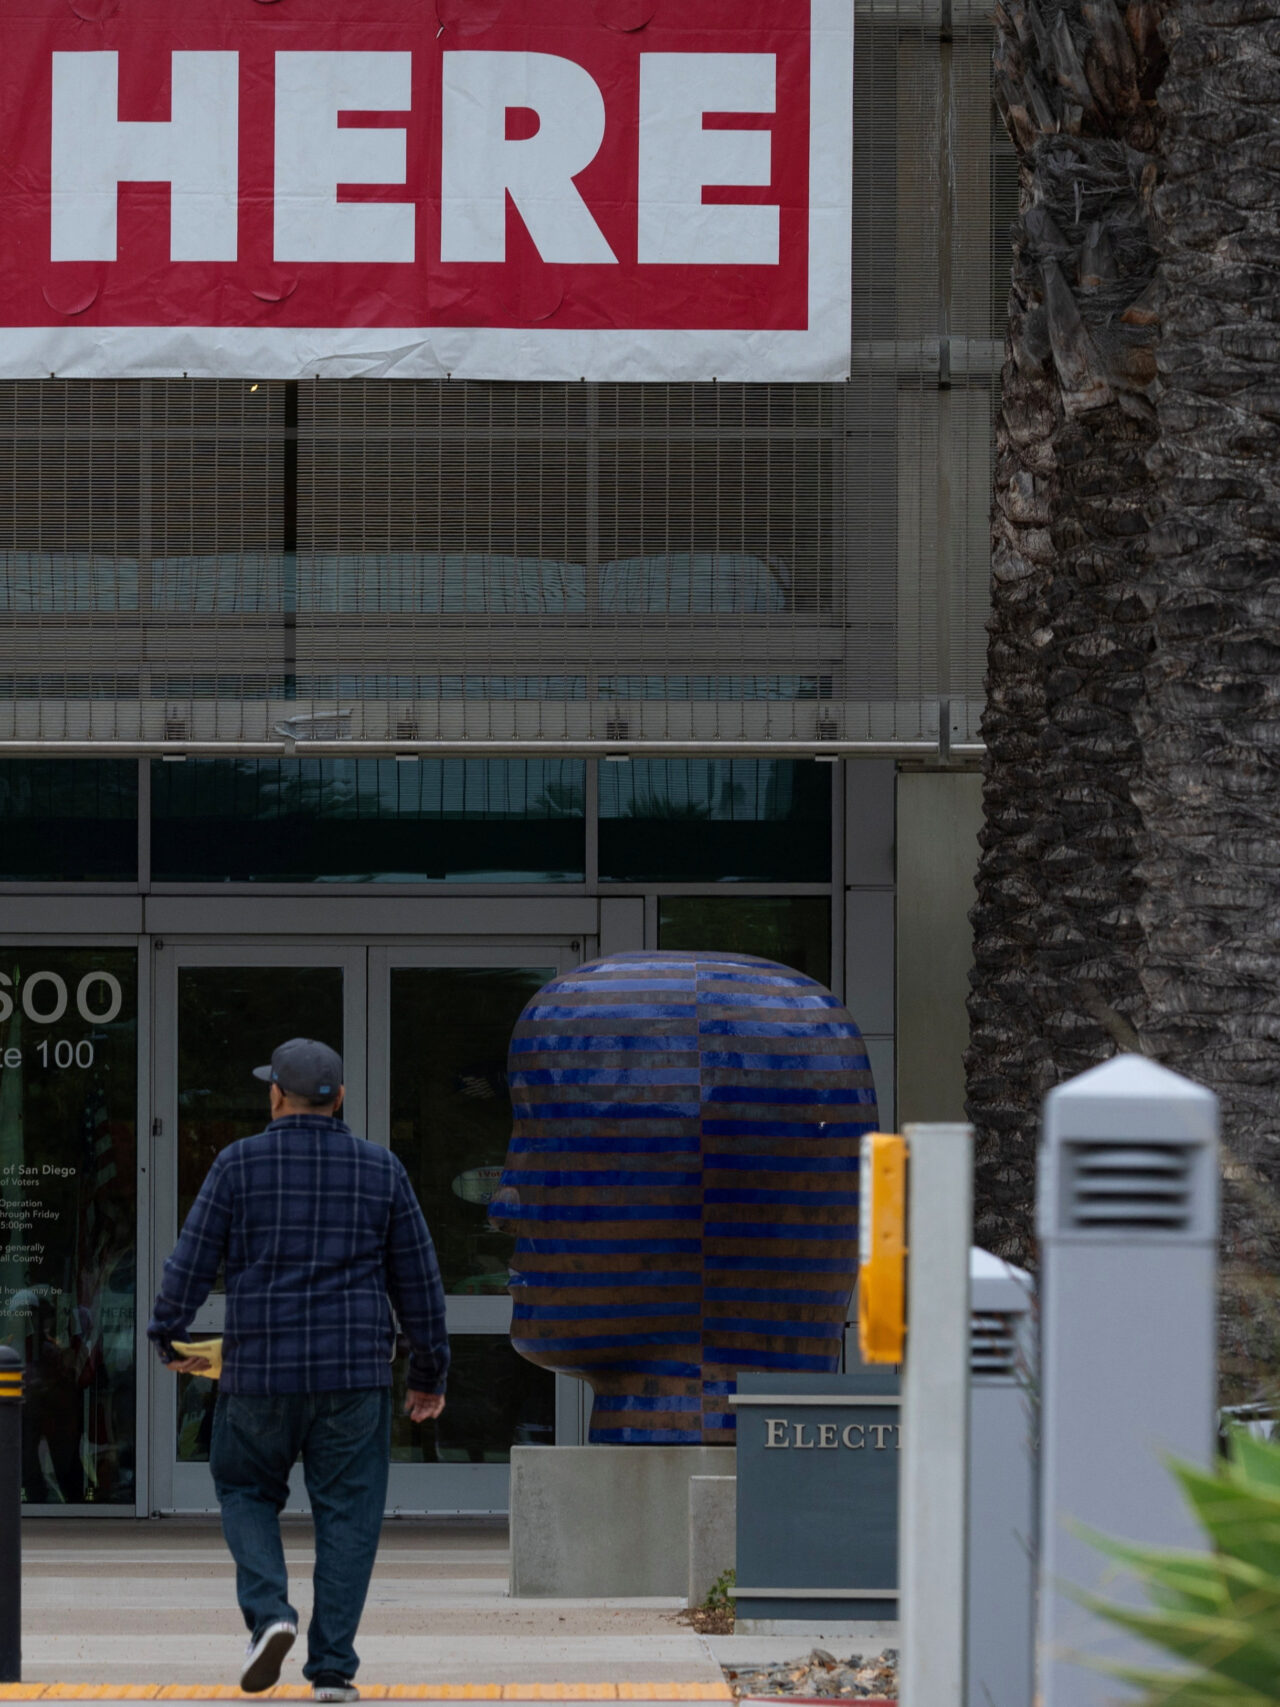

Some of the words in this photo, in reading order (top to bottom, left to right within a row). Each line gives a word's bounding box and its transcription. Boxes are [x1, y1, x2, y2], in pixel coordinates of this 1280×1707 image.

[50, 50, 780, 265] HERE
[36, 1040, 94, 1069] 100
[3, 1164, 15, 1175] of
[18, 1164, 38, 1175] San
[42, 1164, 76, 1178] Diego
[0, 1178, 9, 1186] of
[11, 1178, 40, 1186] Voters
[33, 1210, 60, 1220] Friday
[0, 1221, 33, 1231] 5:00pm
[5, 1243, 45, 1254] generally
[0, 1254, 10, 1262] all
[12, 1254, 44, 1265] County
[4, 1286, 29, 1295] hou
[32, 1288, 48, 1297] may
[51, 1286, 63, 1295] be
